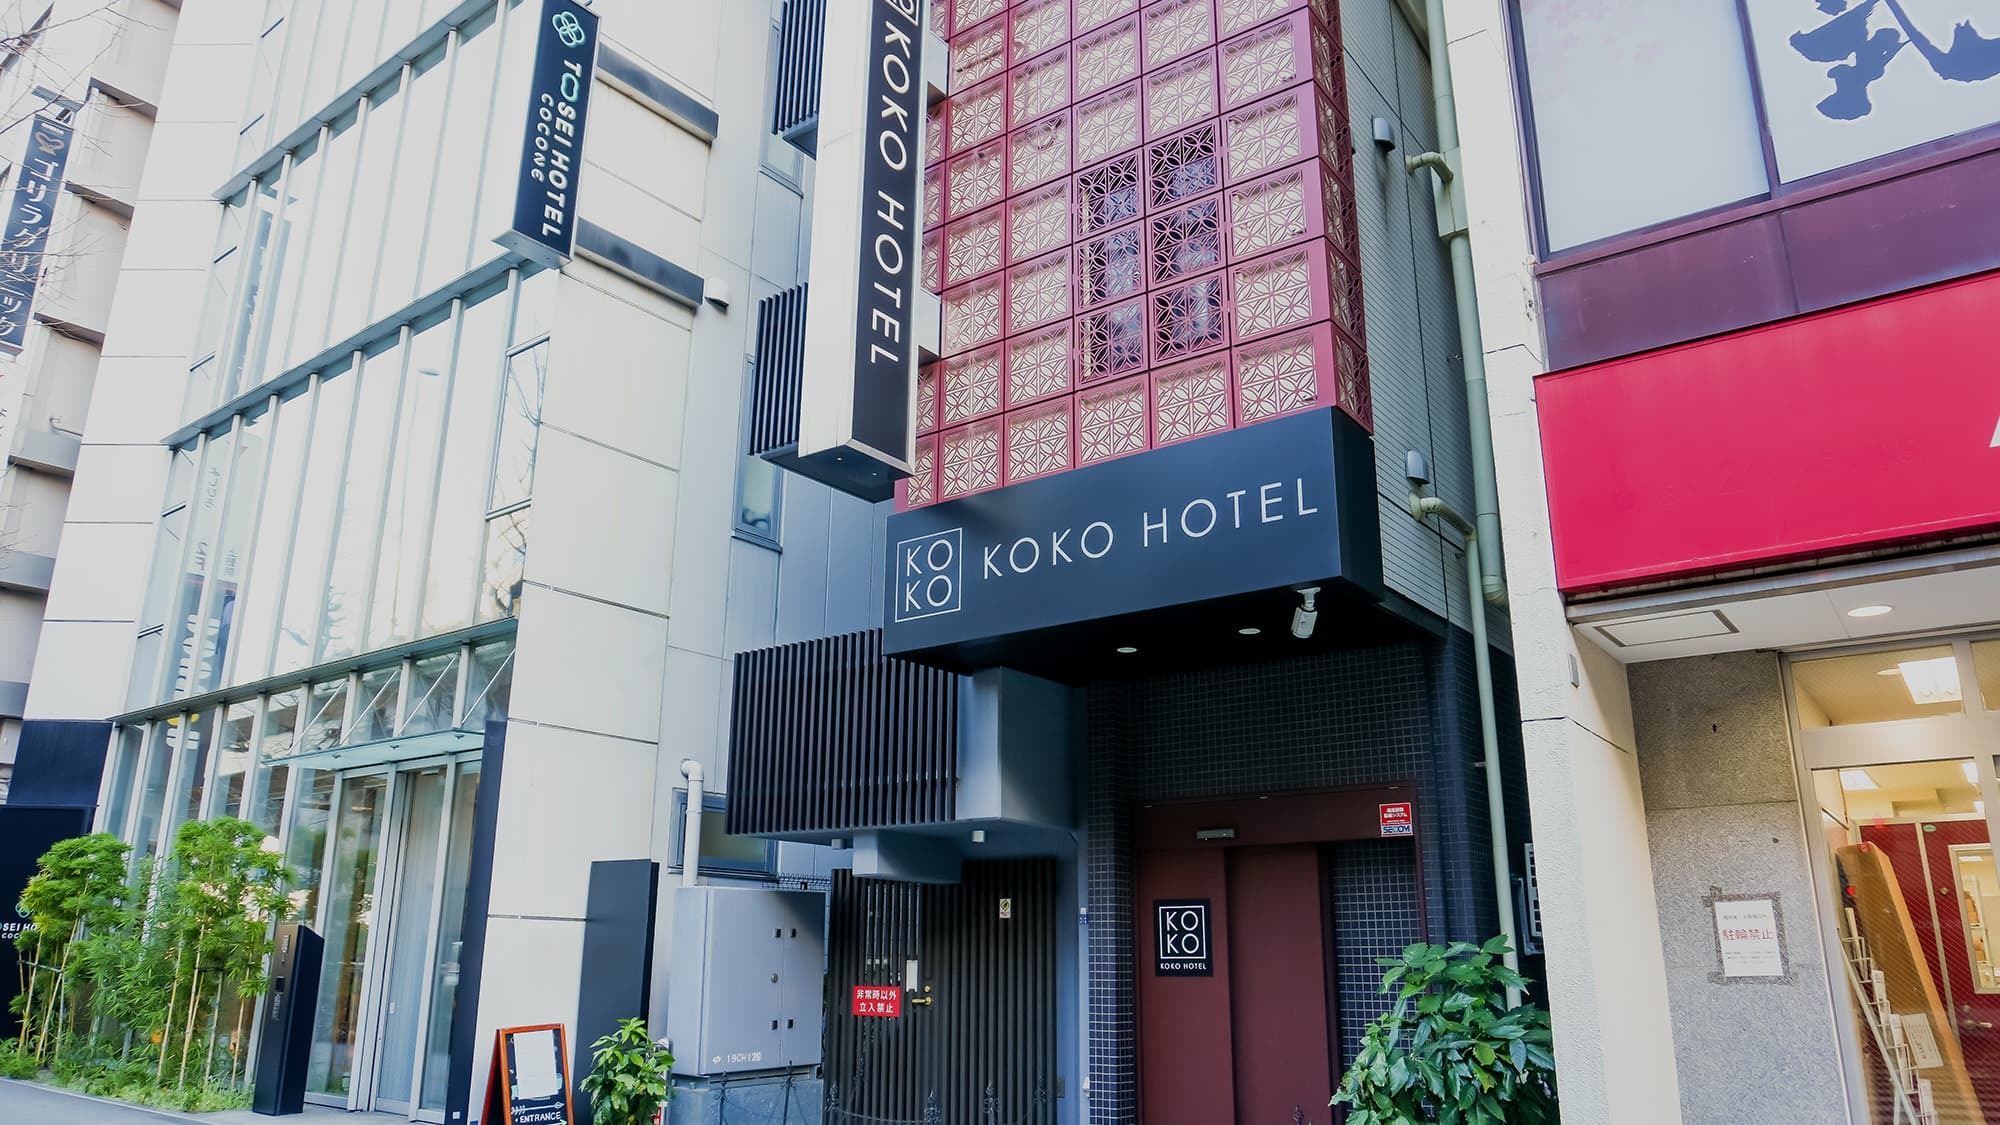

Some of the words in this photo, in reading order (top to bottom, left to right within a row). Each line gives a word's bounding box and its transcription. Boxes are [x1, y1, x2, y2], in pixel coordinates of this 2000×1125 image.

[554, 59, 582, 148] TOSEI
[878, 20, 911, 171] KOKO
[542, 149, 571, 237] HOTEL
[870, 190, 905, 364] HOTEL
[983, 521, 1114, 580] KOKO
[1143, 478, 1318, 547] HOTEL
[906, 539, 952, 577] KO
[905, 575, 952, 612] KO
[1166, 910, 1199, 931] KO
[1167, 933, 1200, 954] KO
[1160, 962, 1181, 970] KOKO
[1183, 962, 1207, 970] HOTEL
[856, 989, 897, 1001] 非常時以外
[859, 1002, 894, 1013] 立入禁止
[519, 1111, 561, 1124] ENTRANCE
